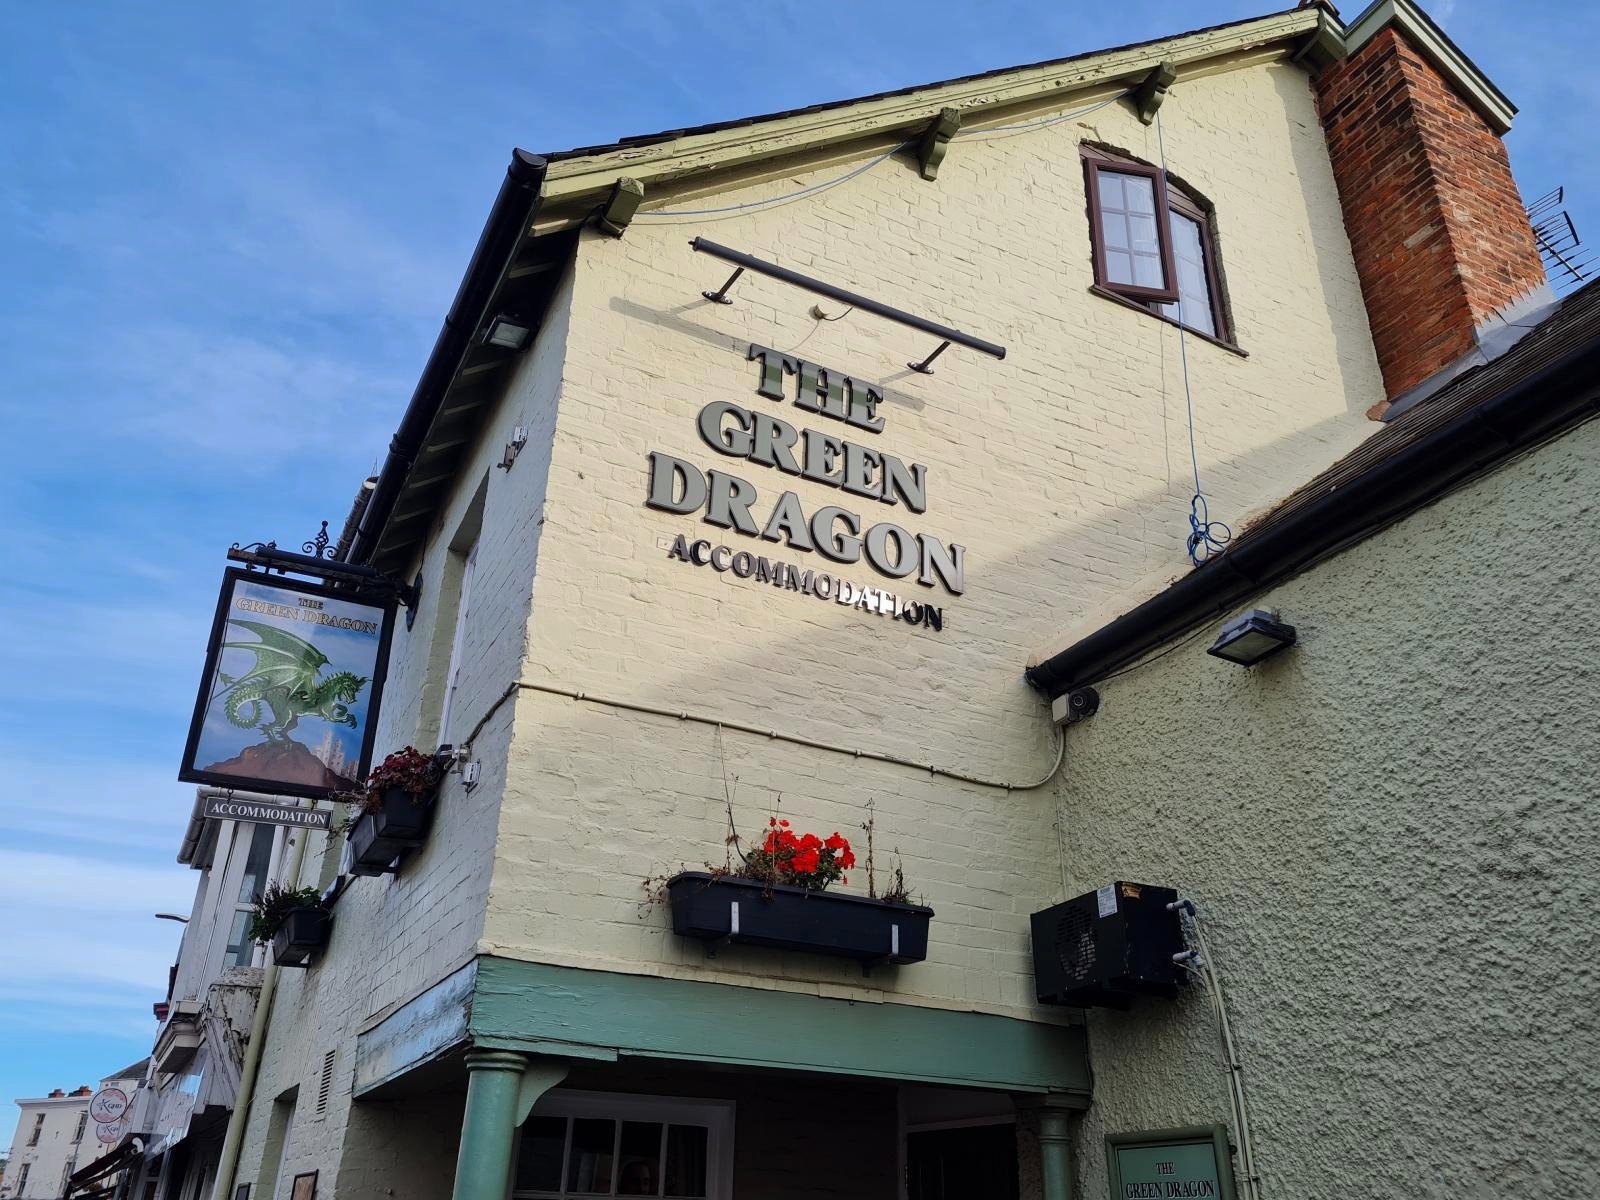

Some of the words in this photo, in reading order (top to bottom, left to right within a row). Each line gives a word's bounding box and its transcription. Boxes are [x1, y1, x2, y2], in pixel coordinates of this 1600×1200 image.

[748, 343, 886, 434] THE
[697, 400, 927, 513] GREEN
[646, 451, 966, 595] DRAGON
[668, 534, 943, 631] ACCOMMODATION
[236, 599, 300, 621] GREEN
[302, 611, 378, 635] DRAGON
[298, 597, 324, 610] THE
[211, 803, 327, 825] ACCOMMODATION
[1156, 1163, 1175, 1175] THE
[1126, 1181, 1163, 1199] GREEN
[1167, 1179, 1216, 1199] DRAGON
